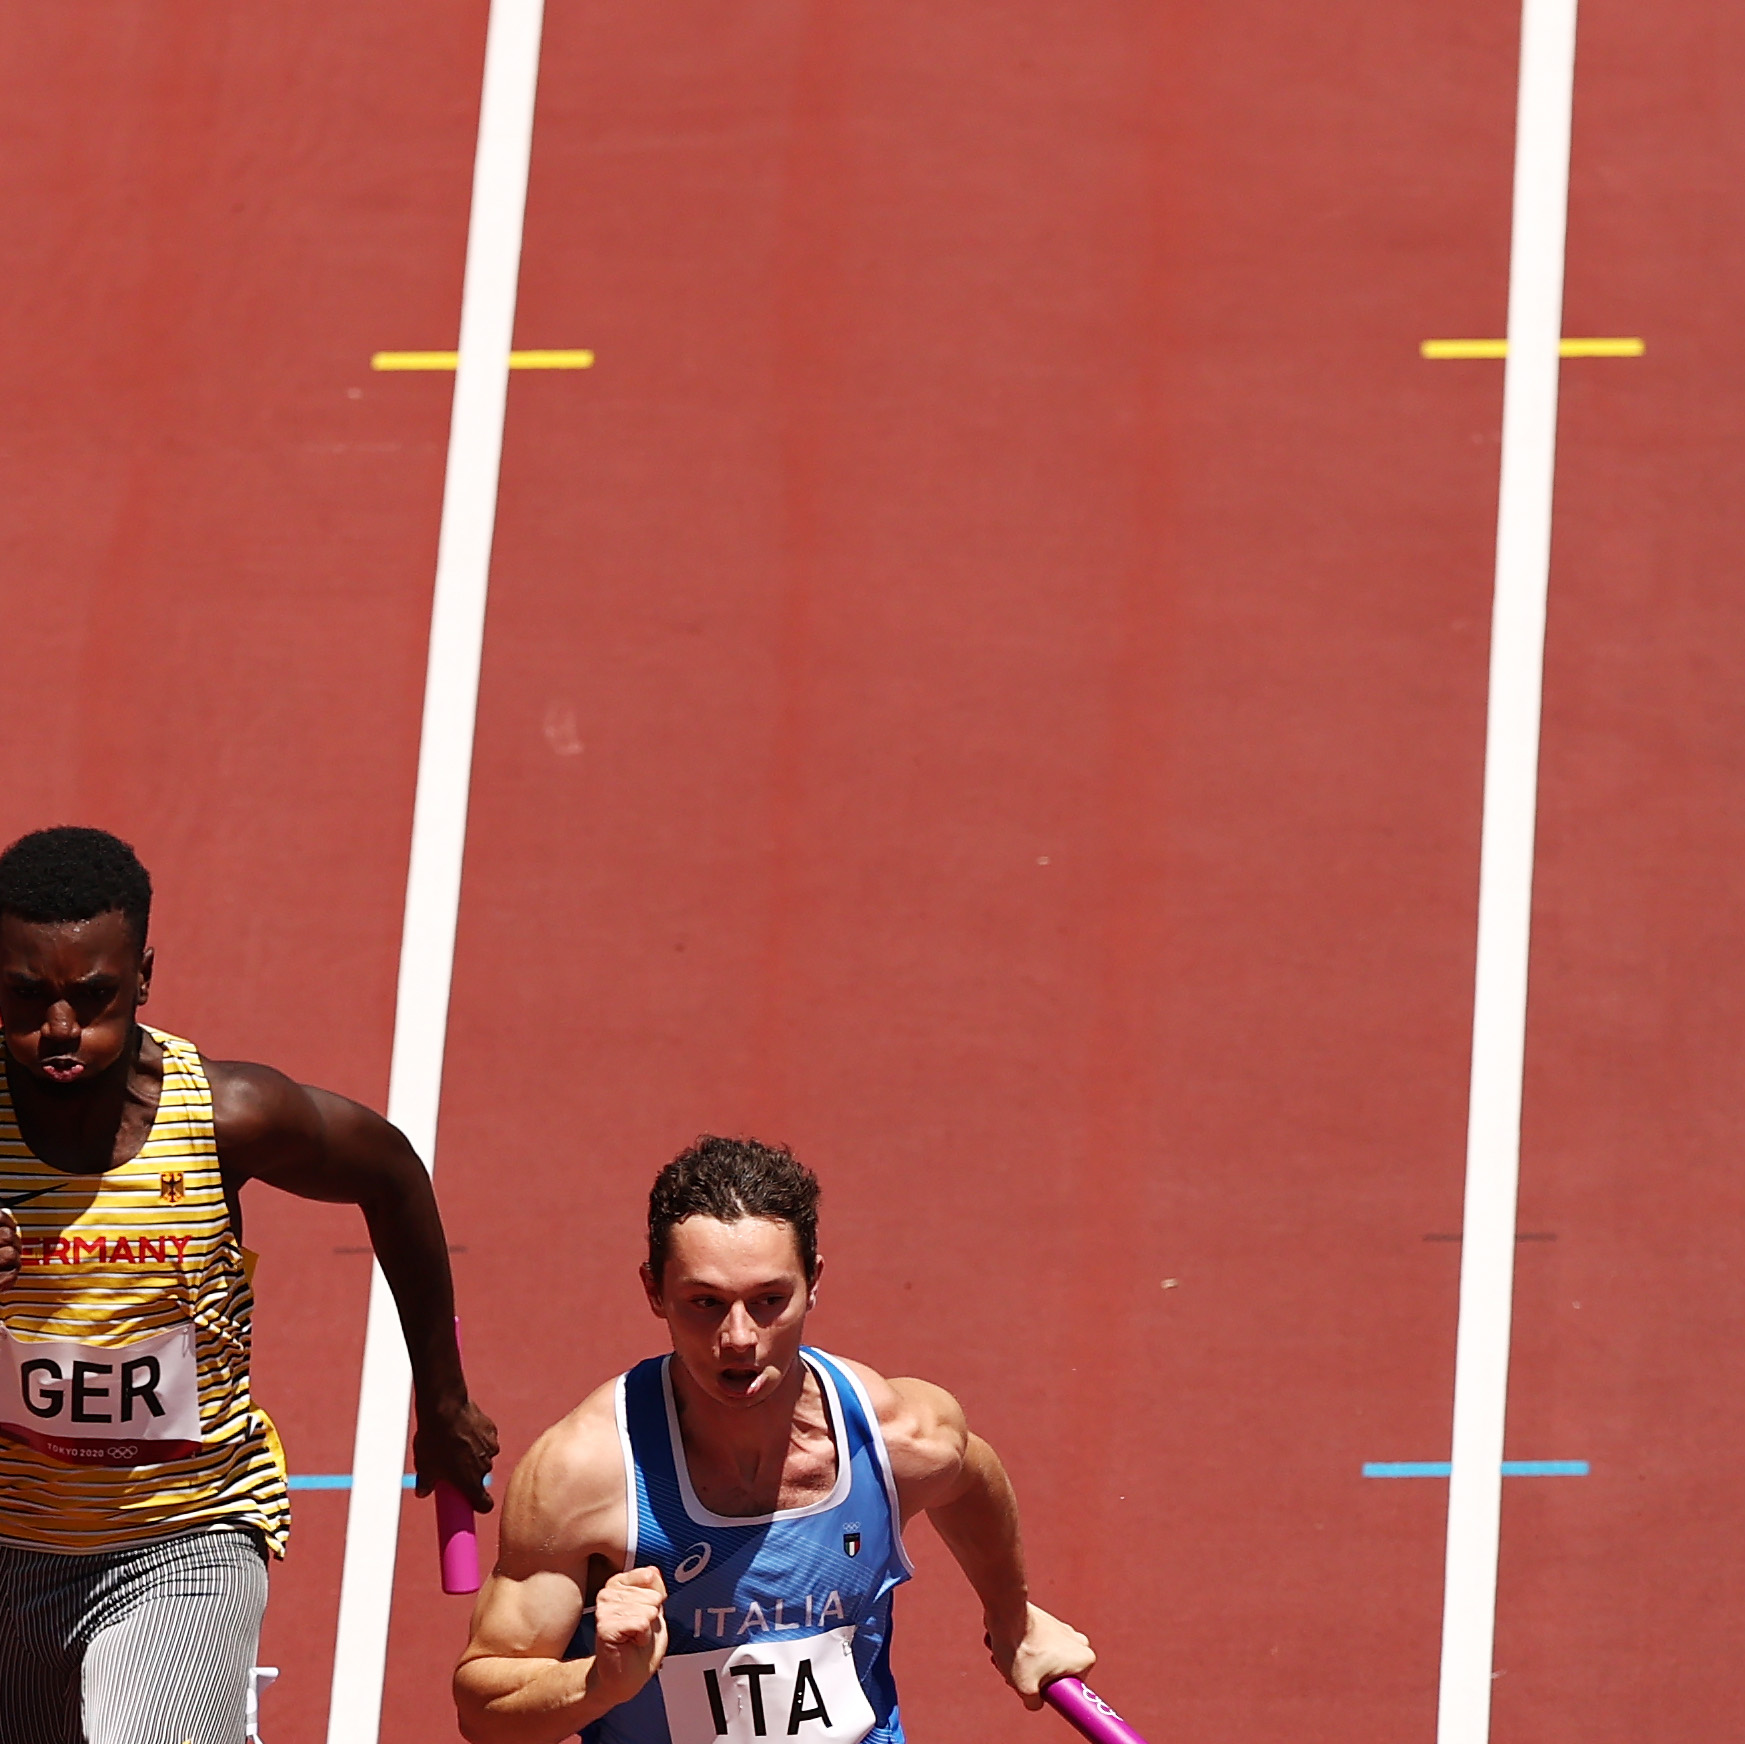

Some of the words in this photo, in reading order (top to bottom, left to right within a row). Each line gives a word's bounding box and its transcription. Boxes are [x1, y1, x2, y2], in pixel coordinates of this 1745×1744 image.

[20, 1235, 192, 1266] ERMANY
[20, 1355, 166, 1424] GER
[47, 1443, 78, 1456] TOKYO
[79, 1449, 104, 1457] 2020
[693, 1590, 845, 1638] ITALIA
[703, 1658, 833, 1737] ITA
